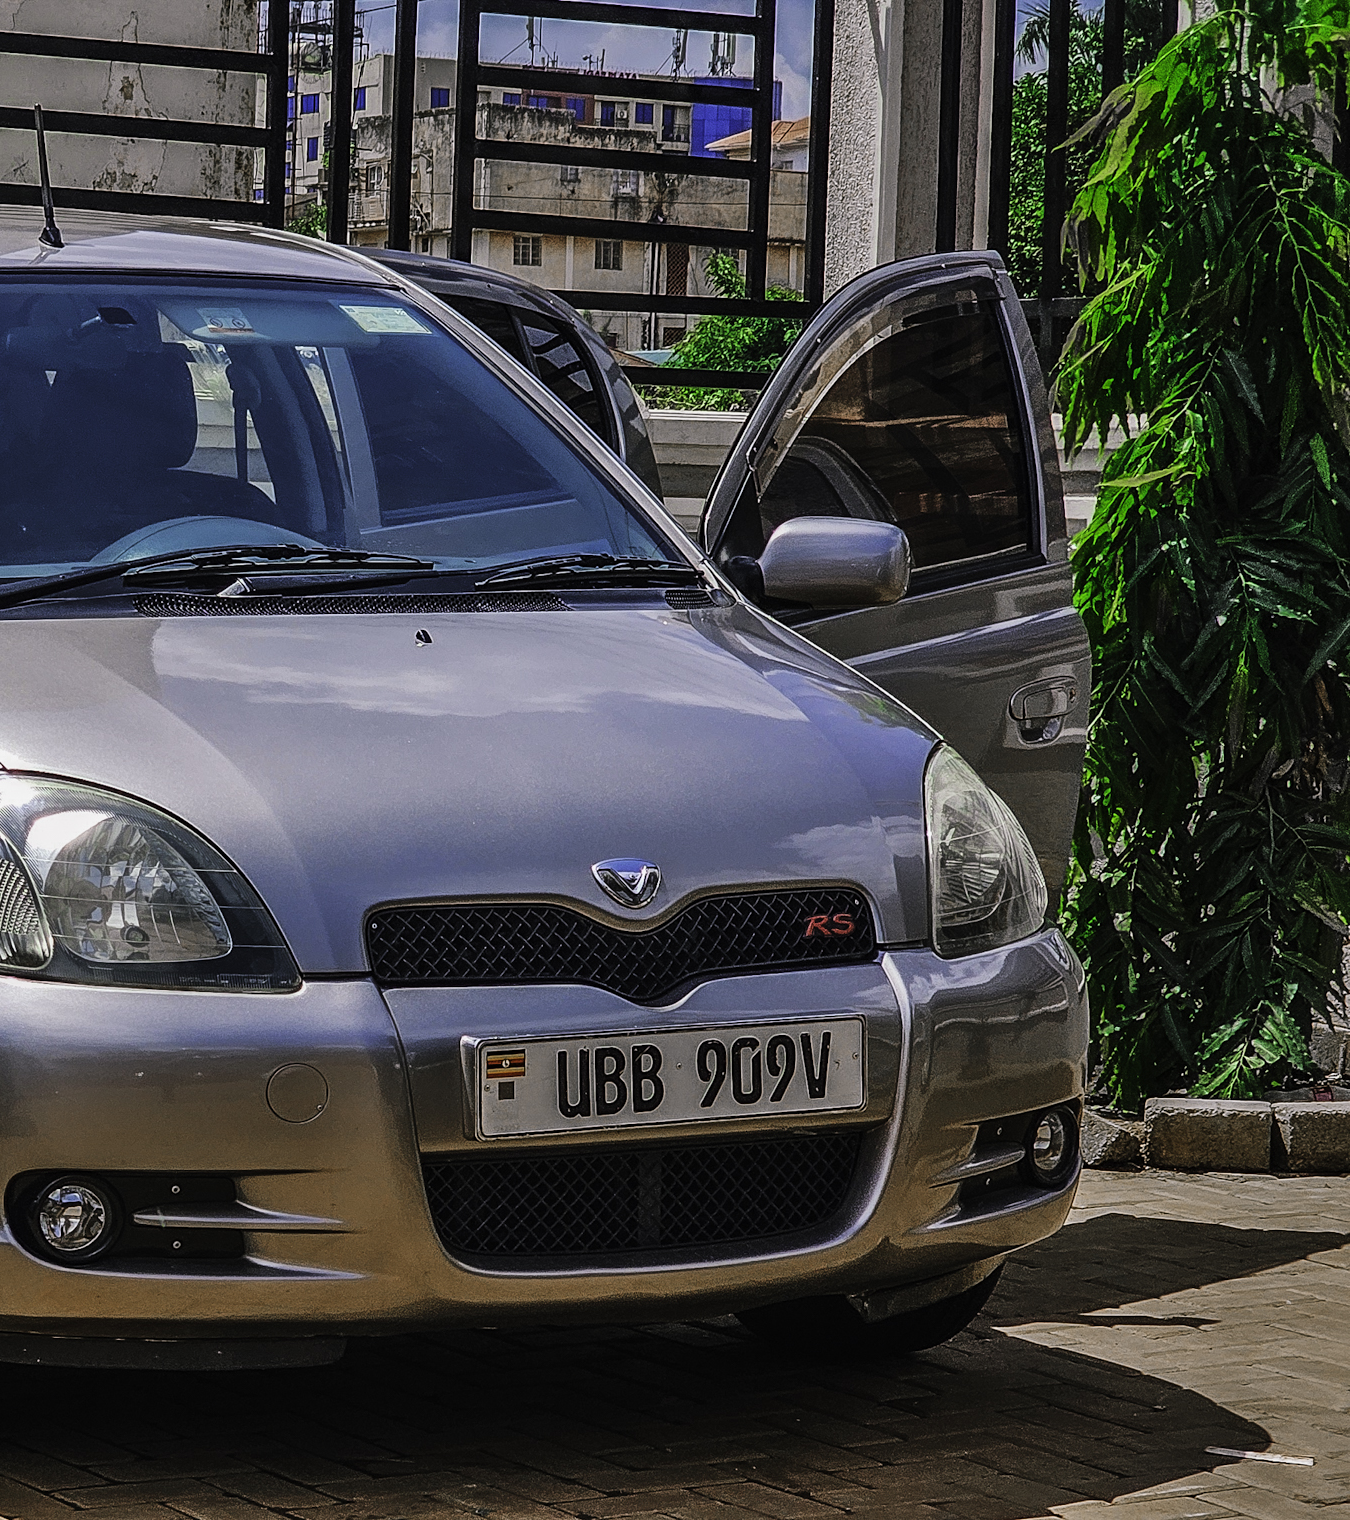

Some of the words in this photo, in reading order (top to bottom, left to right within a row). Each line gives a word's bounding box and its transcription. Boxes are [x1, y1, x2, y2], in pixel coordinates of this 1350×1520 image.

[803, 913, 855, 938] RS
[557, 1044, 665, 1119] UBB
[696, 1031, 832, 1108] 909V
